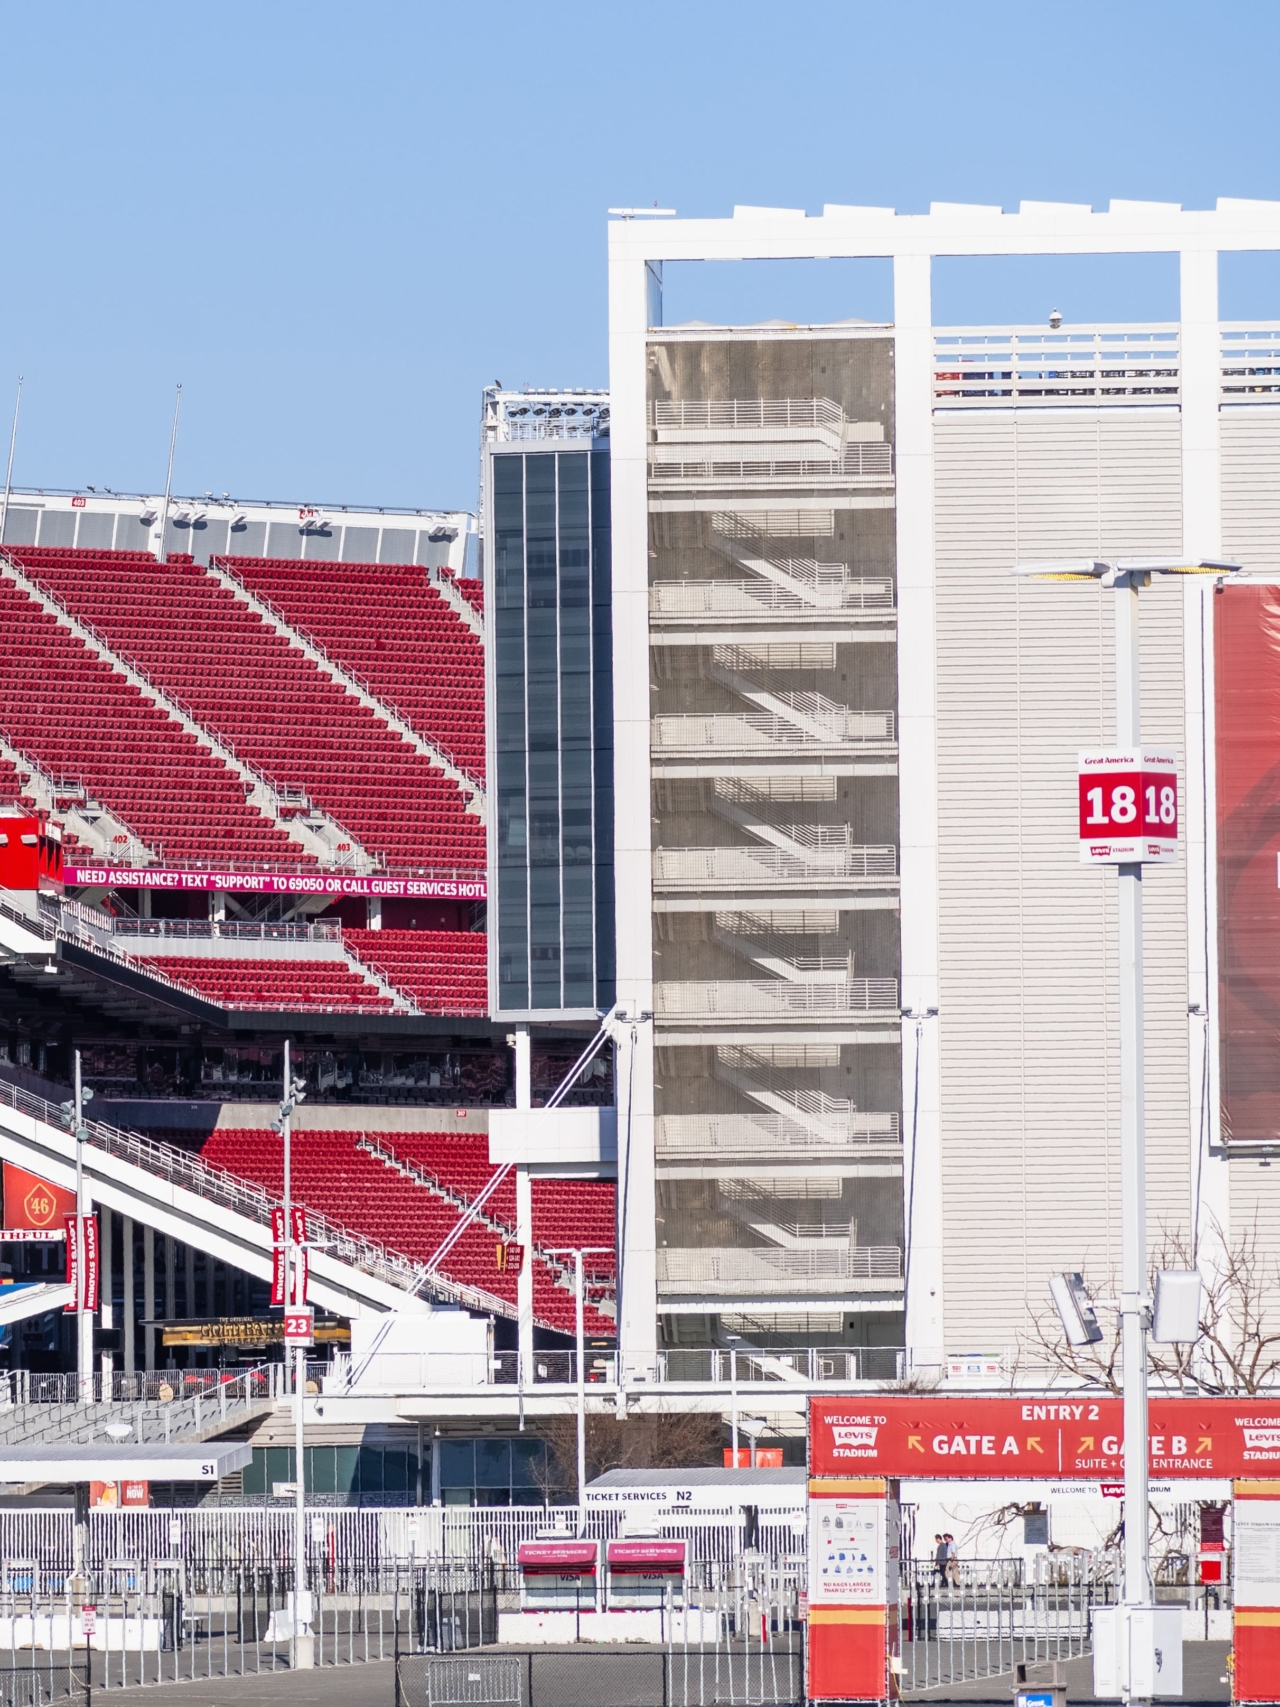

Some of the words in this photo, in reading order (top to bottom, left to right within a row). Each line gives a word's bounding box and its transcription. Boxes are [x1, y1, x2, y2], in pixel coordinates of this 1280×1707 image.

[1085, 757, 1104, 765] Great
[1105, 756, 1135, 764] America
[1086, 785, 1137, 824] 18
[1145, 785, 1176, 824] 18
[113, 836, 128, 844] 402
[336, 843, 351, 851] 403
[76, 870, 107, 883] NEED
[108, 870, 179, 886] ASSISTANCE?
[181, 874, 209, 887] TEXT
[272, 877, 287, 889] TO
[288, 878, 324, 891] 69050
[325, 879, 342, 892] OR
[343, 880, 370, 893] CALL
[371, 881, 406, 894] GUEST
[406, 882, 457, 896] SERVICES
[458, 884, 487, 897] HOTL
[276, 1253, 285, 1301] STADIUM
[87, 1261, 96, 1308] STADIUM
[286, 1319, 308, 1334] 23
[1021, 1404, 1084, 1421] ENTRY
[1087, 1405, 1100, 1420] 2
[824, 1415, 872, 1425] WELCOME
[873, 1416, 887, 1424] TO
[932, 1435, 996, 1455] GATE
[1001, 1436, 1020, 1455] A
[1101, 1435, 1165, 1455] GE
[1172, 1436, 1187, 1455] B
[832, 1449, 878, 1458] STADIUM
[1243, 1451, 1280, 1460] STADIU
[201, 1464, 215, 1475] S1
[1075, 1459, 1108, 1469] SUITE
[1152, 1459, 1213, 1469] ENTRANCE
[126, 1488, 144, 1499] NOW
[586, 1493, 620, 1501] TICKET
[622, 1492, 667, 1501] SERVICES
[676, 1491, 693, 1501] N2
